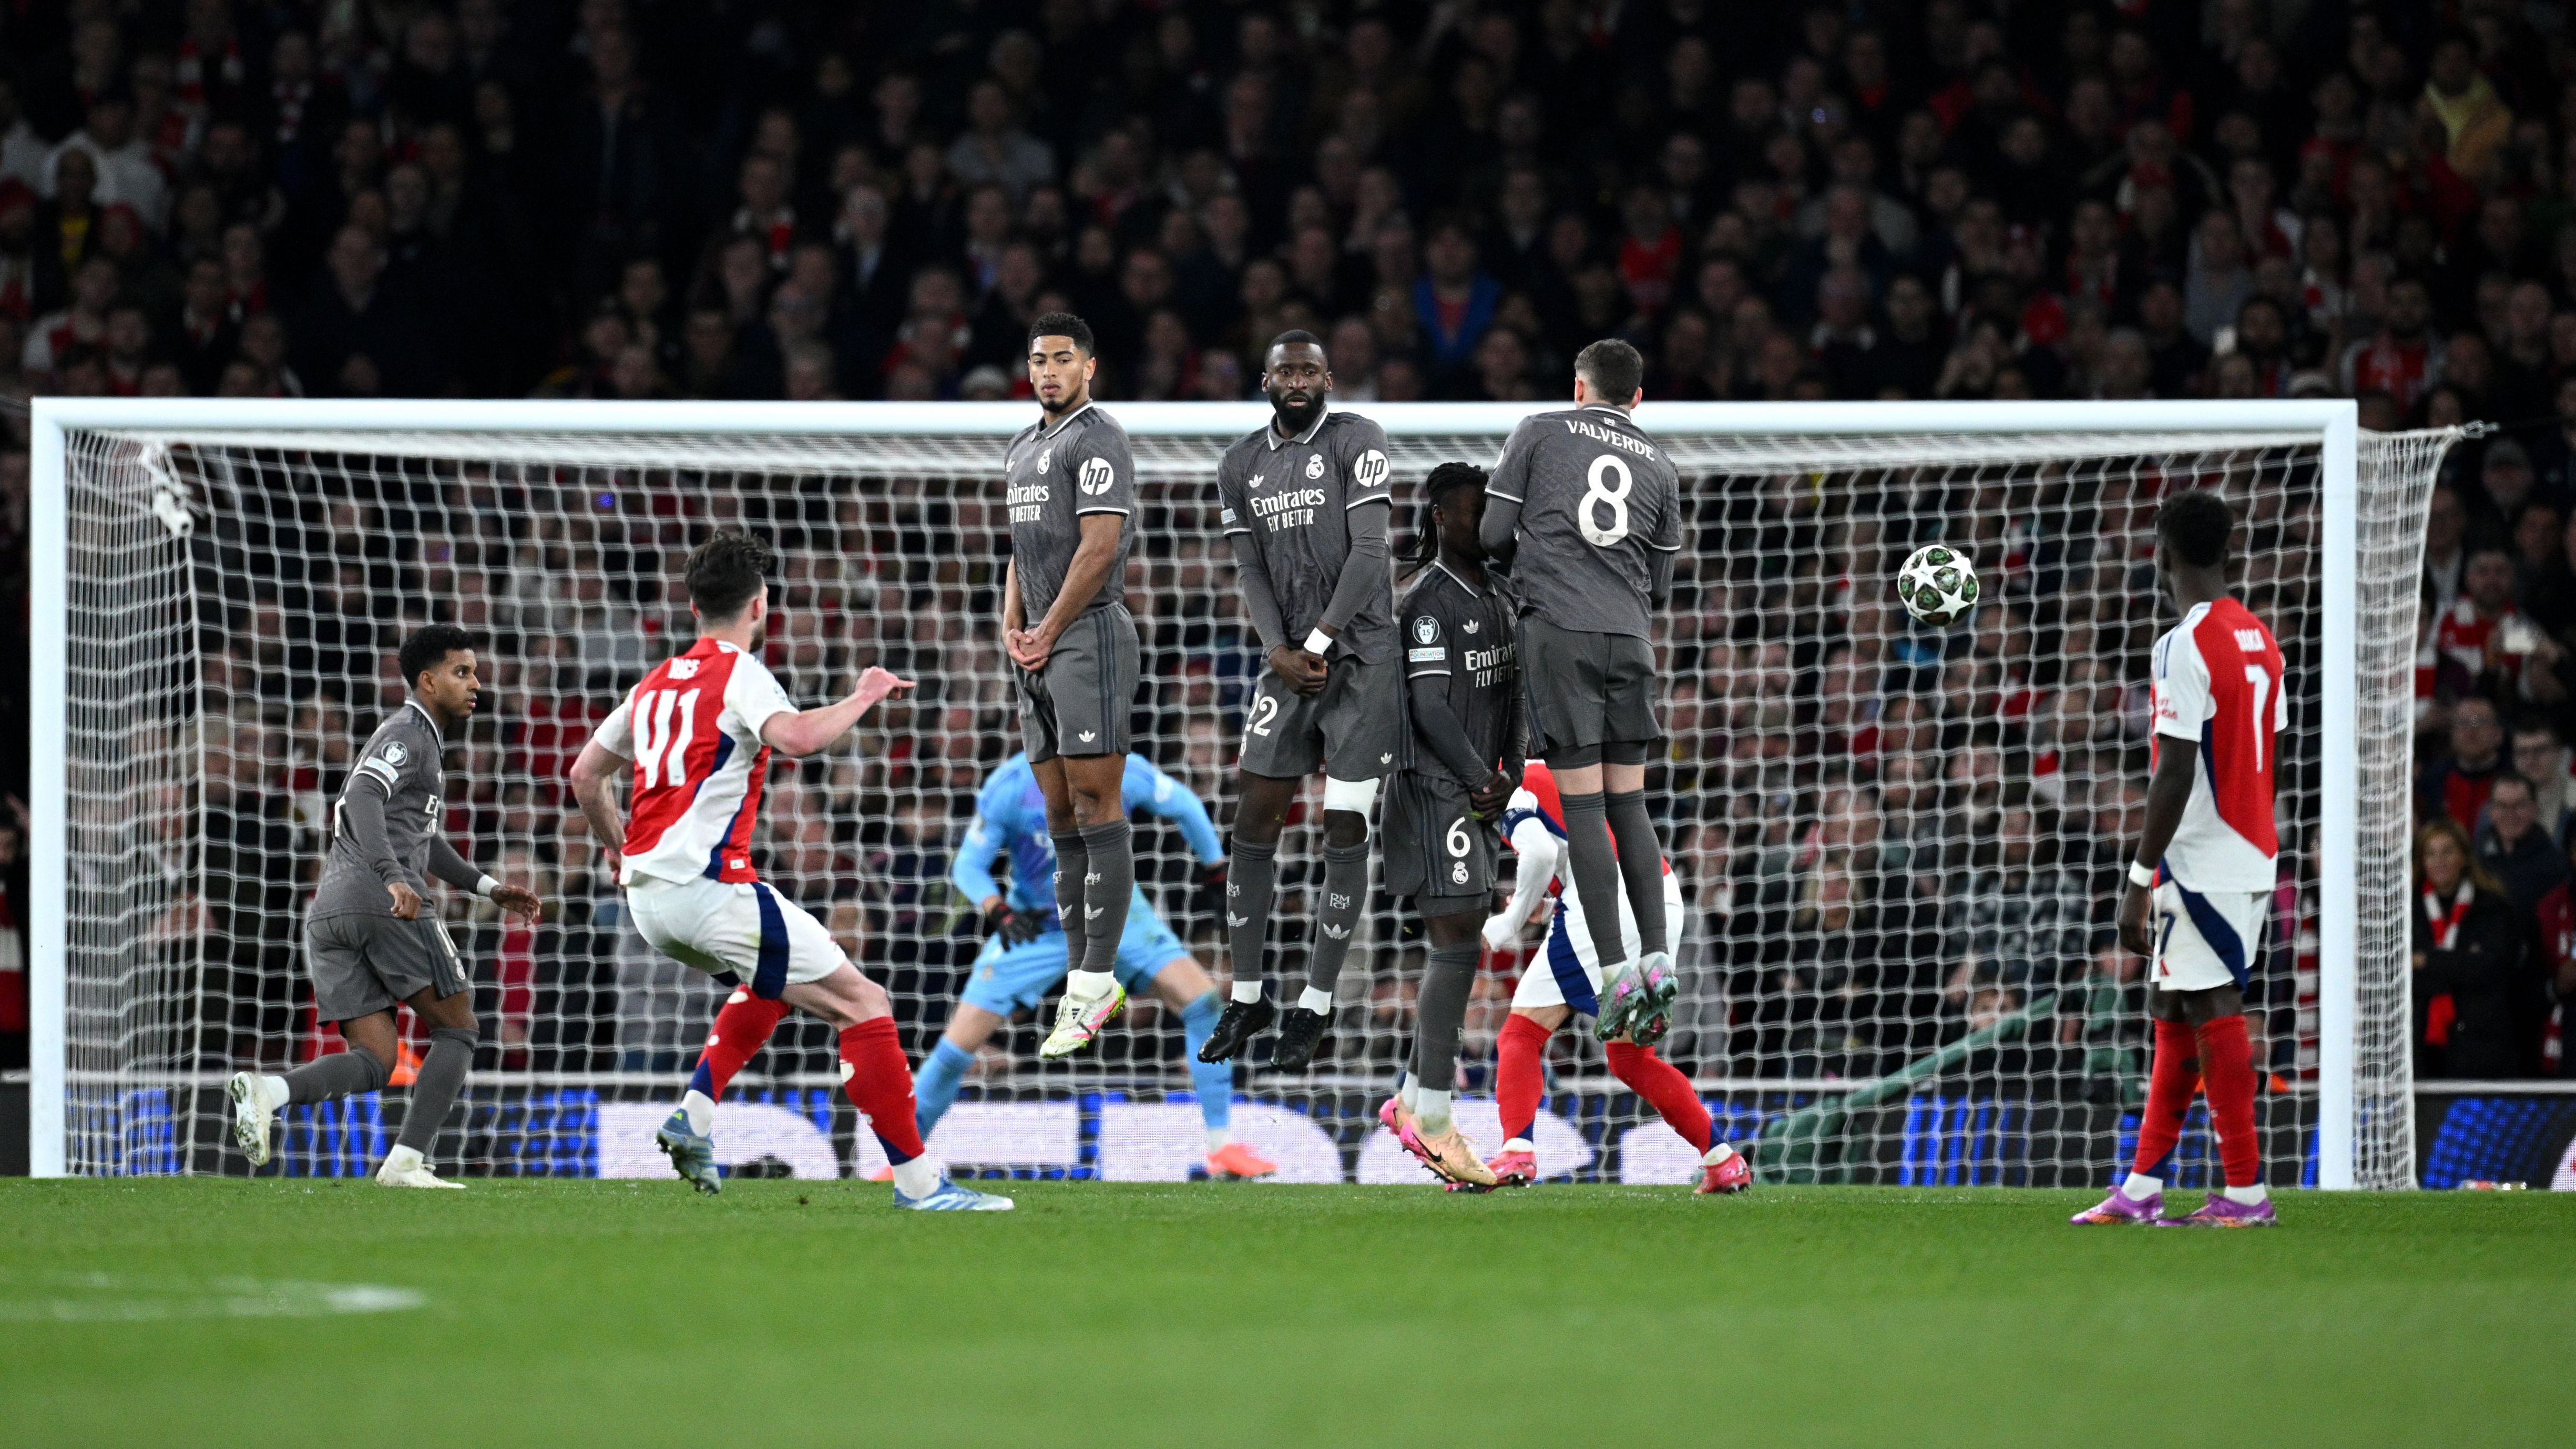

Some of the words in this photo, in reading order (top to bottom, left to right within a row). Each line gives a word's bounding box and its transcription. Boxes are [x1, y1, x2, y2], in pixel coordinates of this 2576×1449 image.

[1565, 420, 1655, 462] VALVERDE
[1082, 457, 1110, 495] hp
[1358, 450, 1385, 488] hp
[1016, 505, 1040, 522] BETTER
[1251, 488, 1325, 517] Emirates
[1578, 454, 1632, 547] 8
[1464, 641, 1516, 670] Emirat
[1476, 669, 1491, 688] FLY
[2245, 665, 2271, 772] 7
[634, 689, 701, 789] 41
[1447, 816, 1470, 858] 6
[2159, 911, 2175, 955] 7
